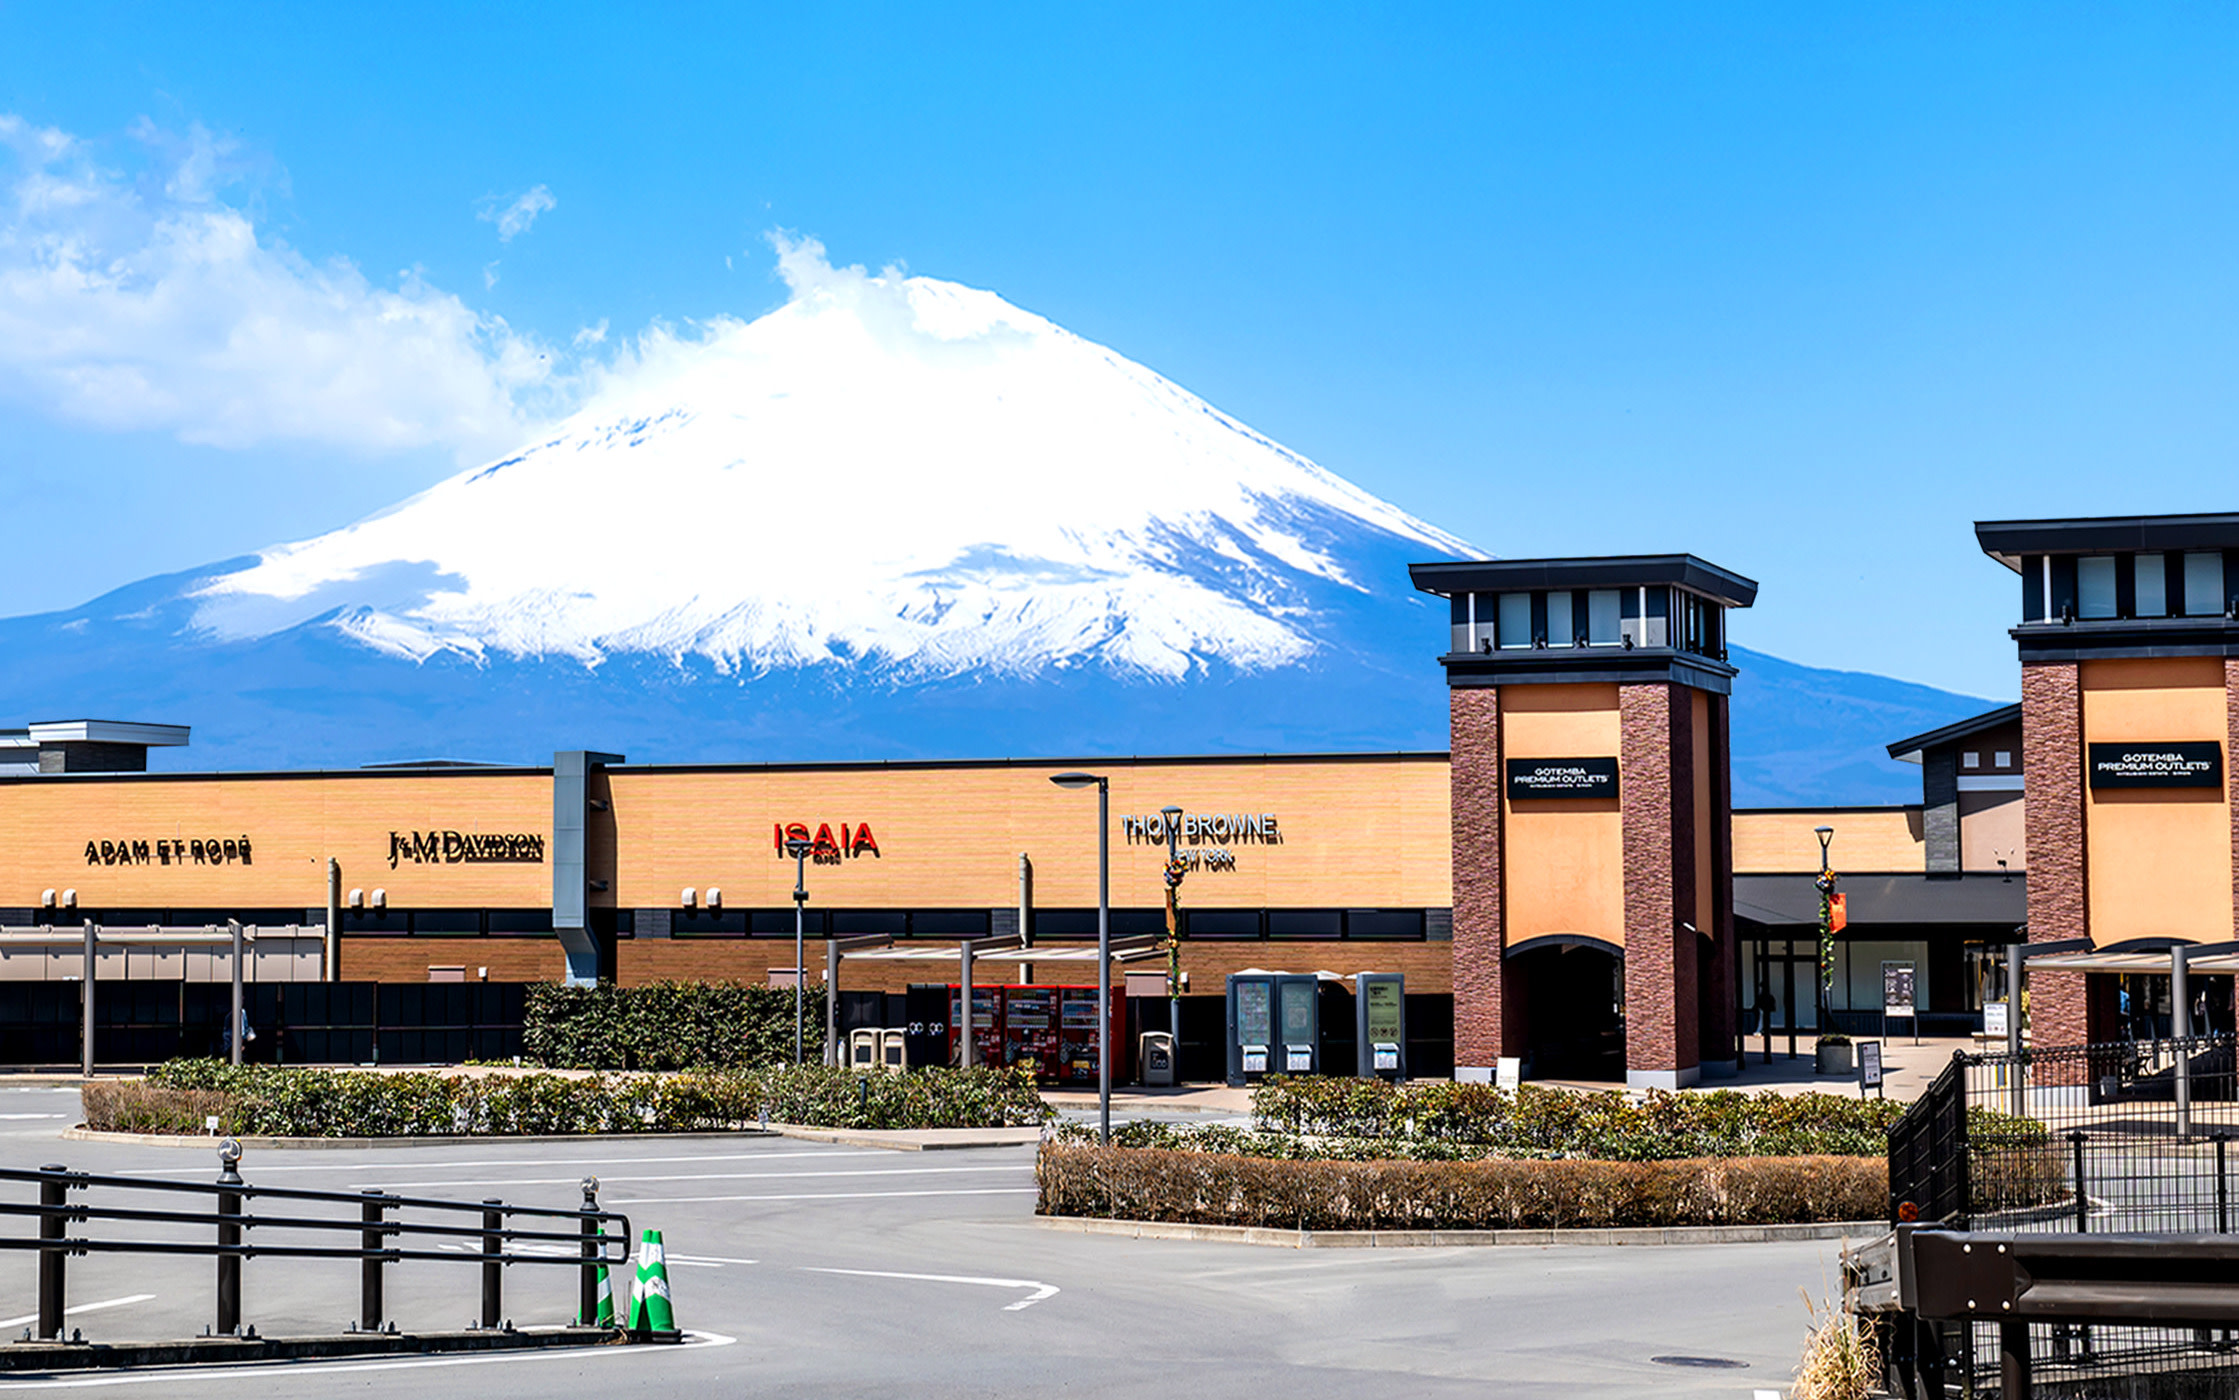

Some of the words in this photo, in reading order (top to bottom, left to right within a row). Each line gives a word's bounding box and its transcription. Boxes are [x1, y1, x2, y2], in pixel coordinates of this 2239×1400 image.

[2122, 753, 2184, 762] GOTEMBA
[2097, 761, 2154, 771] PREMIUM
[1534, 767, 1587, 776] GOTEMBA
[1514, 775, 1560, 784] PREMIUM
[774, 822, 879, 852] ISAIA
[84, 840, 150, 863] ADAM
[156, 839, 185, 863] ET
[190, 835, 252, 863] ROPÉ
[1200, 850, 1234, 867] YORK
